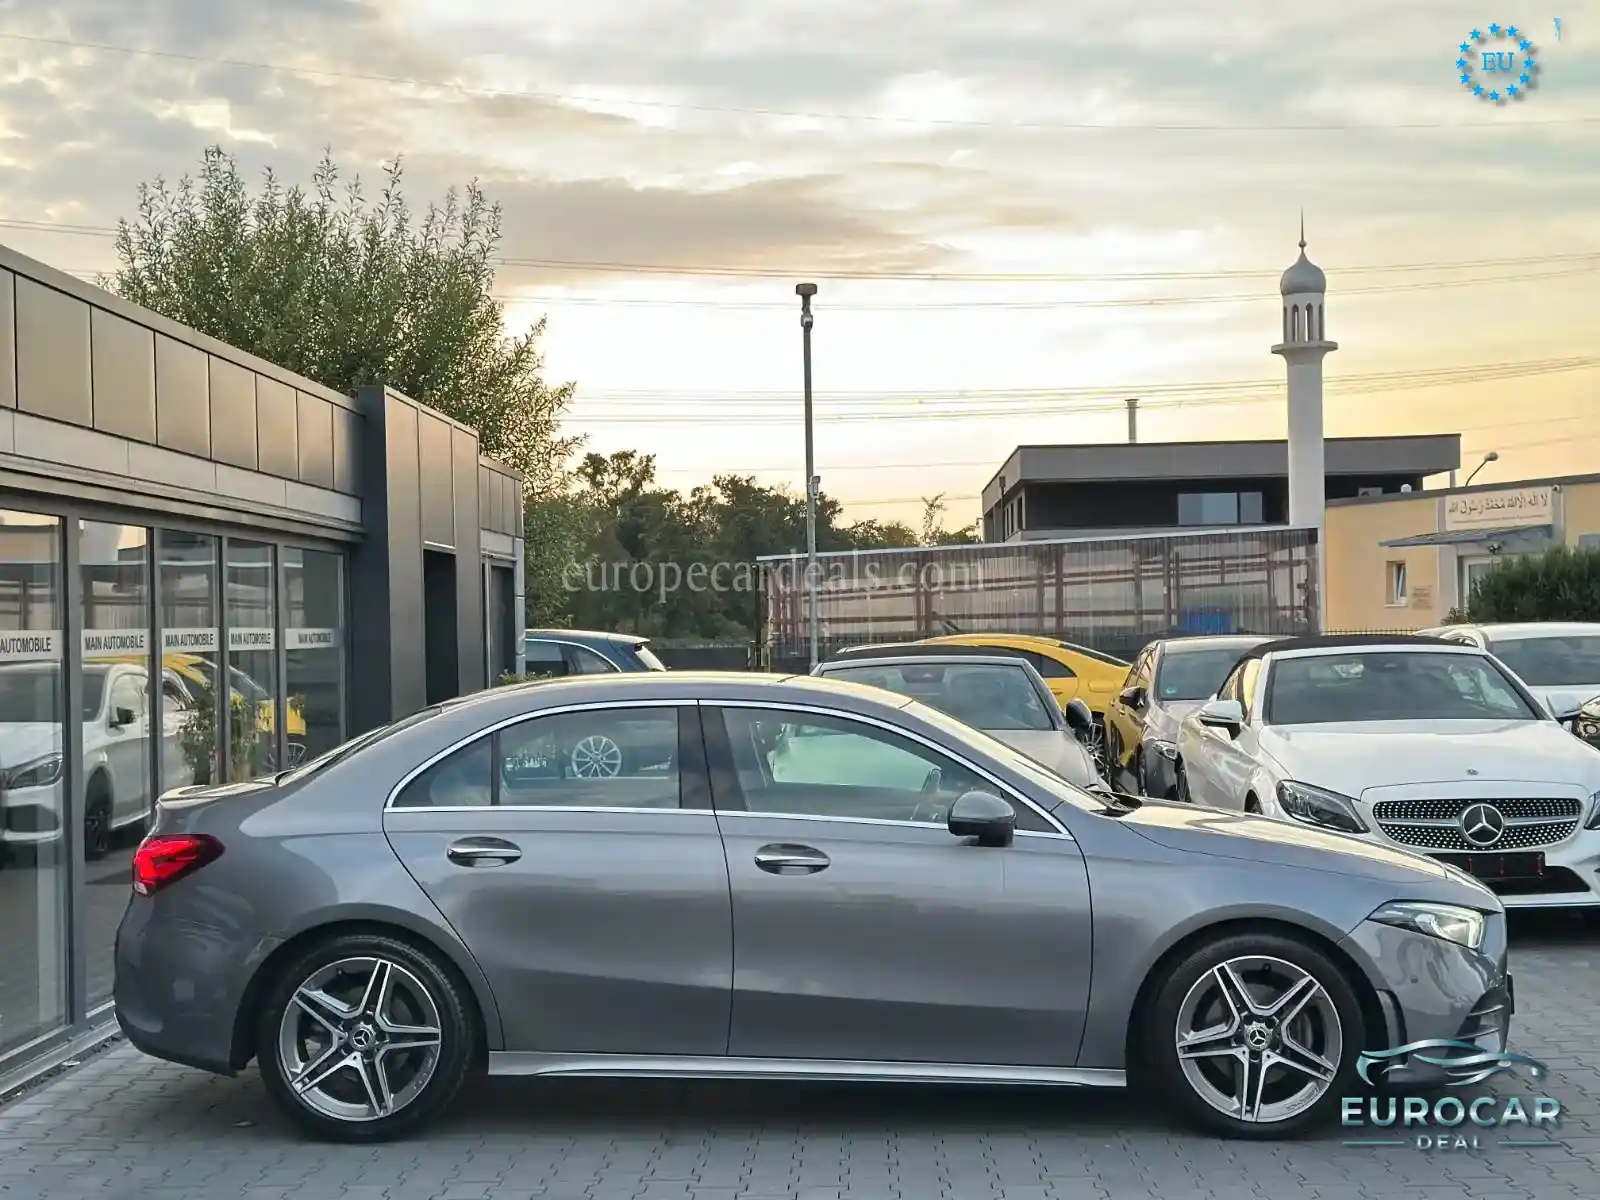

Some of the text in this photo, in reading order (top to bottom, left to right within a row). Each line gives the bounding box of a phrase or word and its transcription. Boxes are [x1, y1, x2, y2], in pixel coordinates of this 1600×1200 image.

[0, 636, 52, 653] AUTOMOBILE
[85, 634, 144, 650] MAIN AUTOMOBILE
[165, 633, 214, 647] MAIN AUTOMOBILE
[230, 632, 271, 645] MAIN AUTOMOBILE
